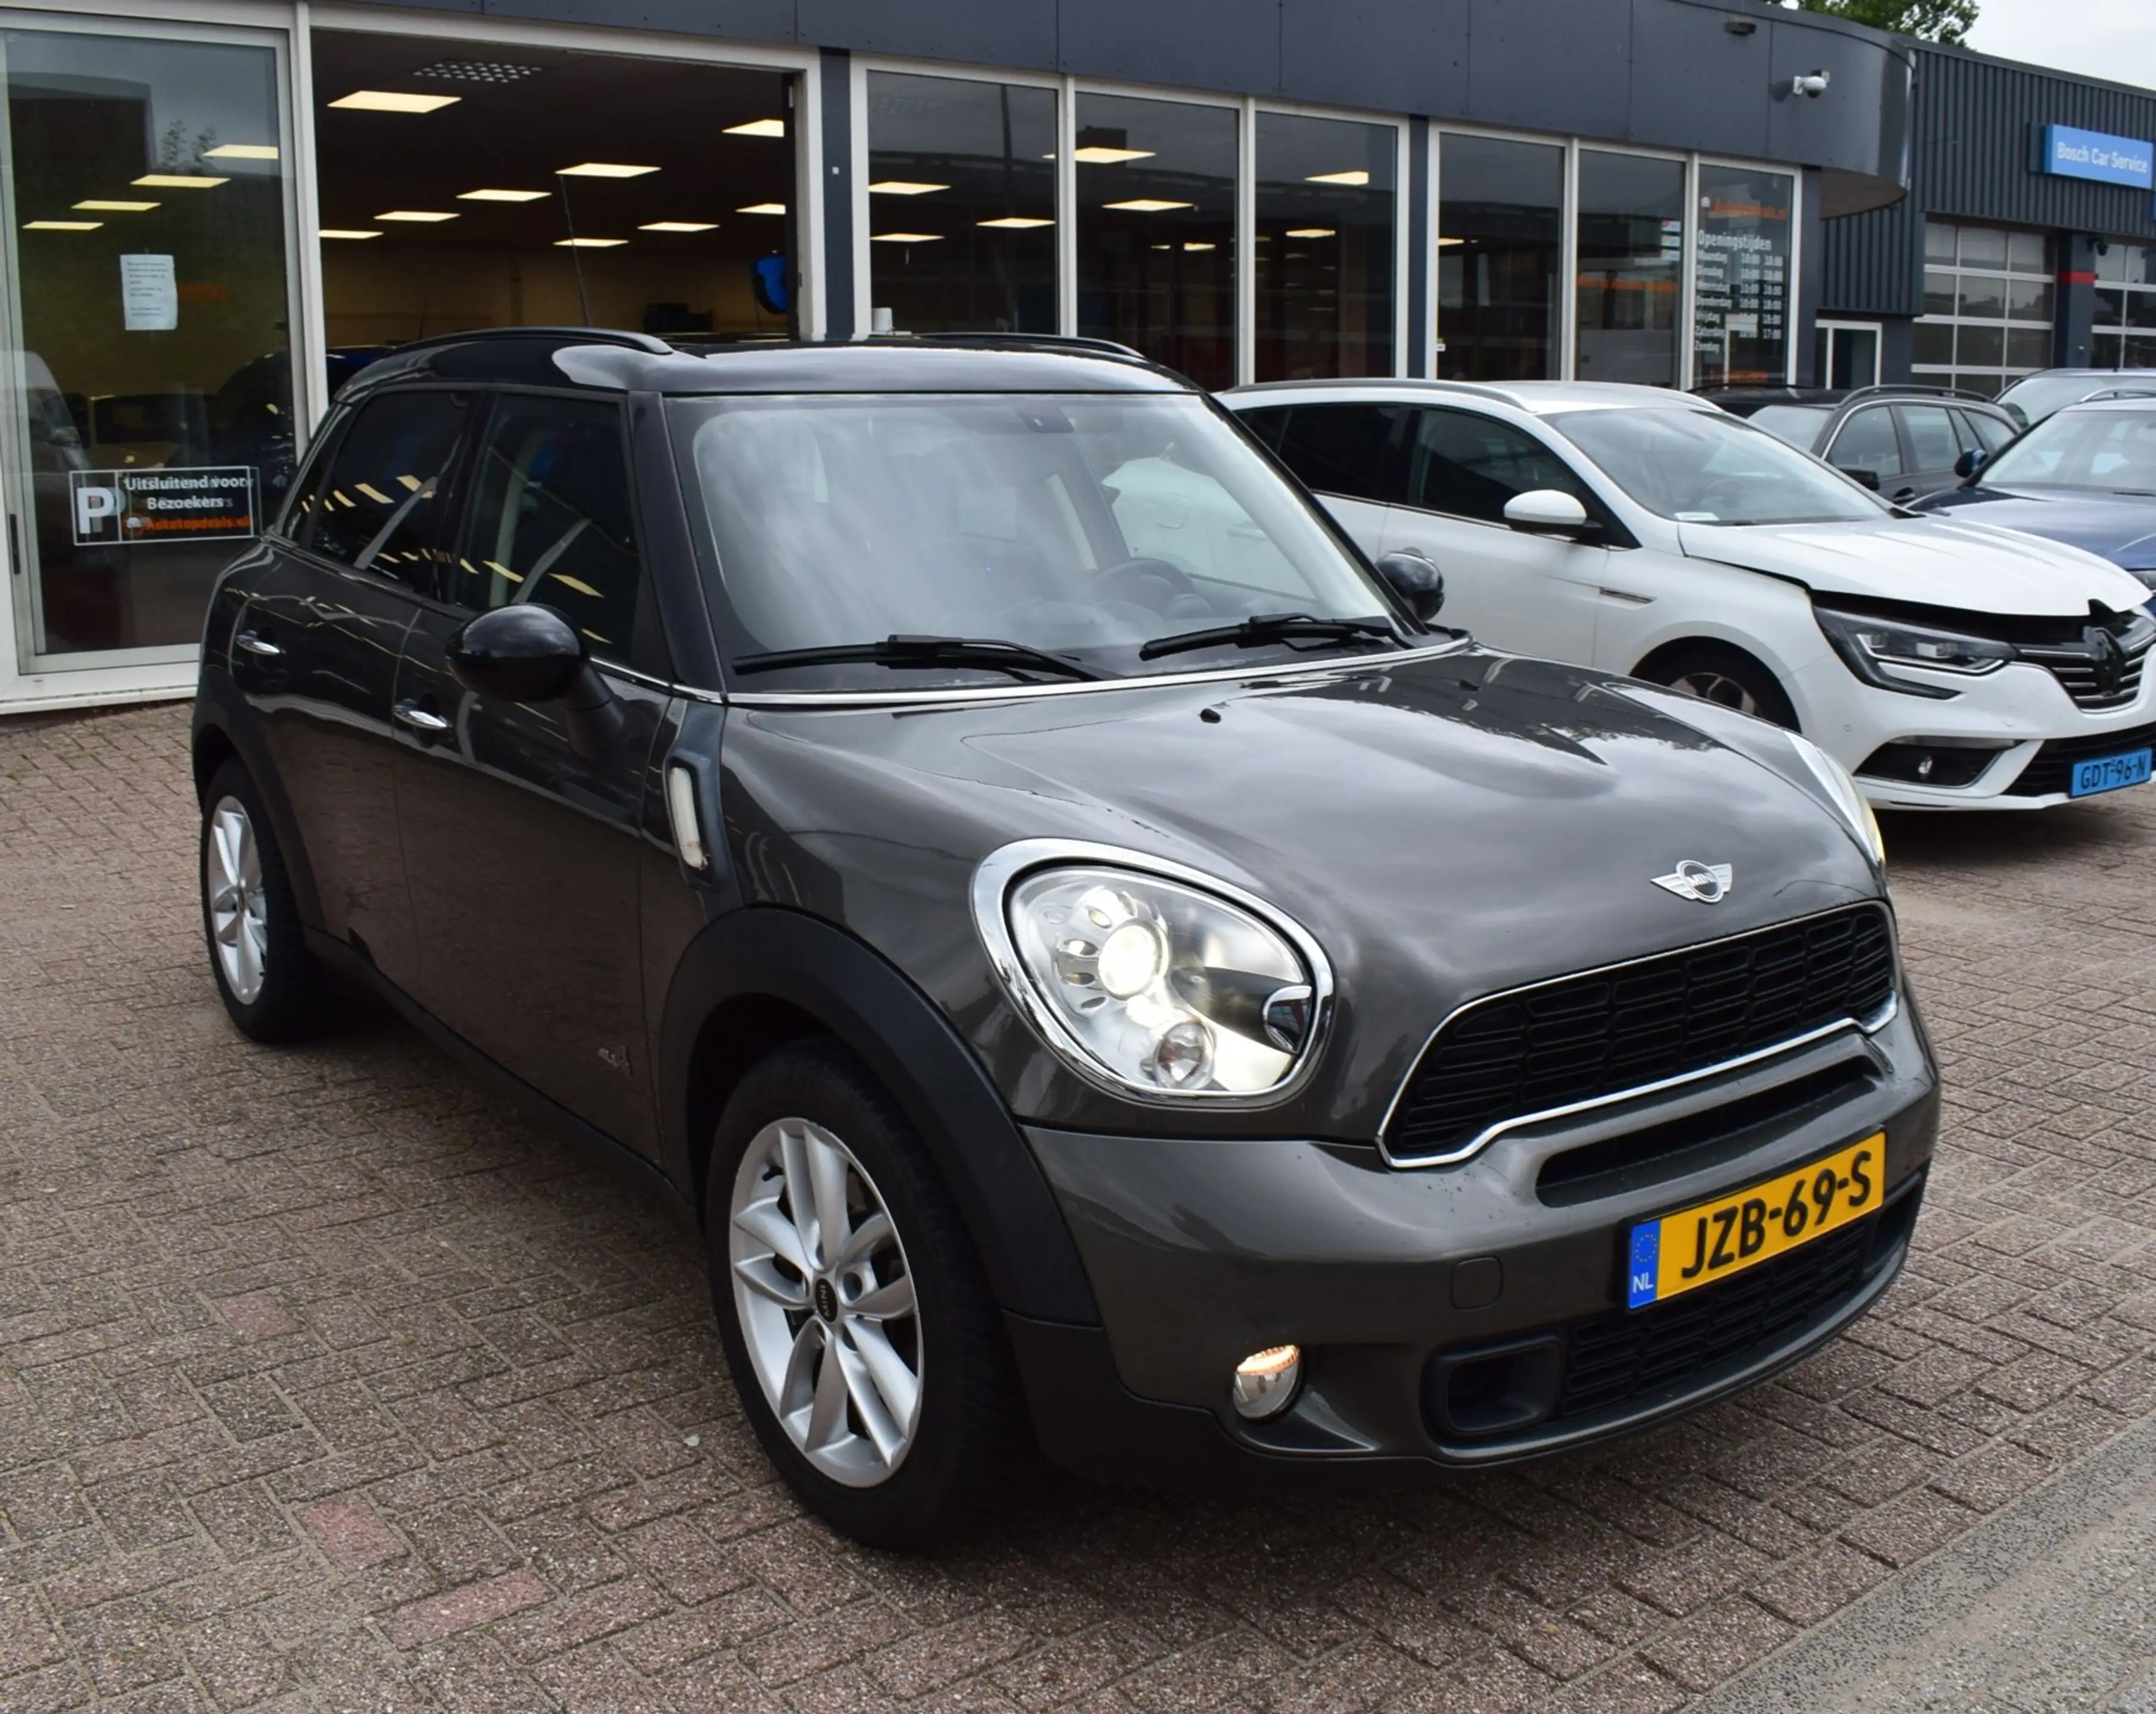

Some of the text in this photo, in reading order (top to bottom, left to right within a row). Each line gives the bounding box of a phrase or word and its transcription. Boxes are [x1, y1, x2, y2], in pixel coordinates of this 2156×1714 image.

[2057, 141, 2148, 174] Bosch Car Service
[1698, 229, 1771, 252] Openingstijden
[124, 476, 245, 491] Uitsluitend voor
[76, 487, 115, 534] P
[146, 495, 224, 510] Bezoekers
[1686, 872, 1717, 887] MINI
[1681, 1150, 1872, 1279] JZB-69-S
[1632, 1272, 1654, 1293] NL
